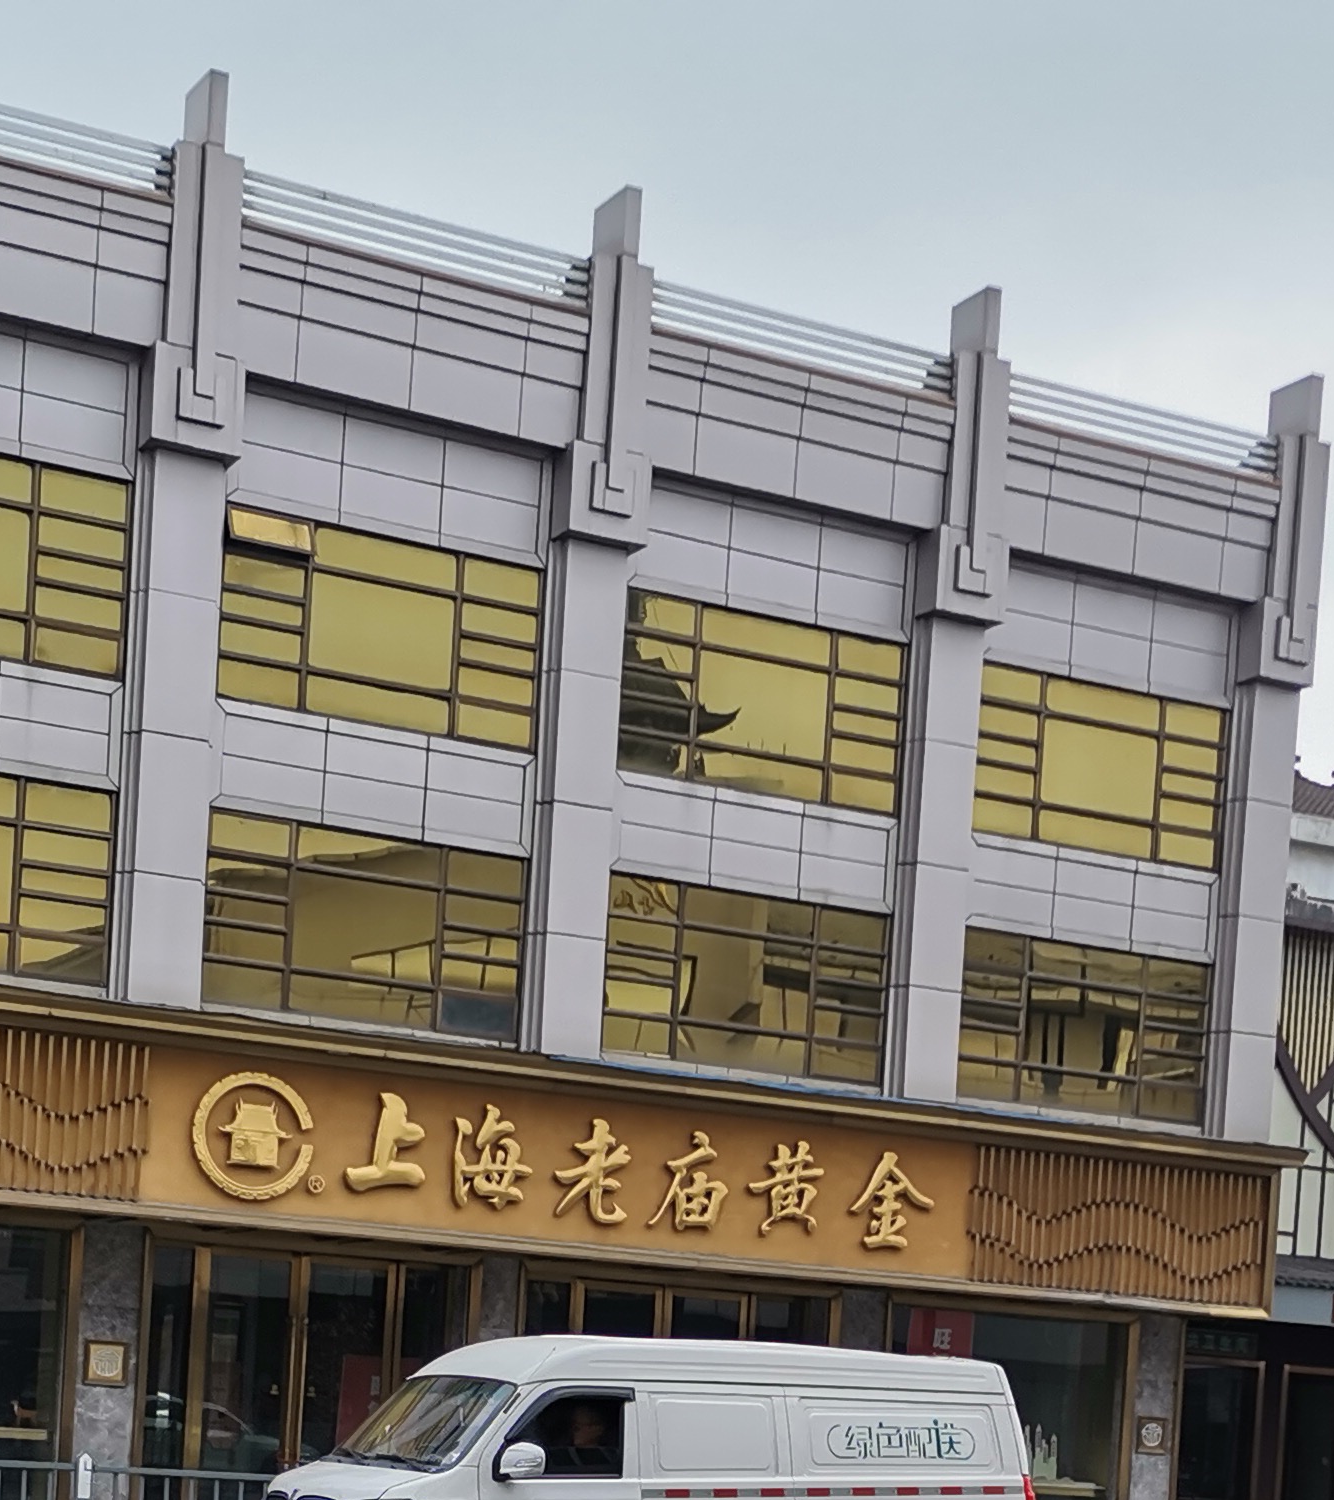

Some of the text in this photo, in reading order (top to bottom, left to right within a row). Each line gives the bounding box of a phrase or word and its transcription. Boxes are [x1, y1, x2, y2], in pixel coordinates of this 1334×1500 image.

[345, 1092, 934, 1248] 上海老庙黄金
[844, 1418, 962, 1460] 绿色配送
